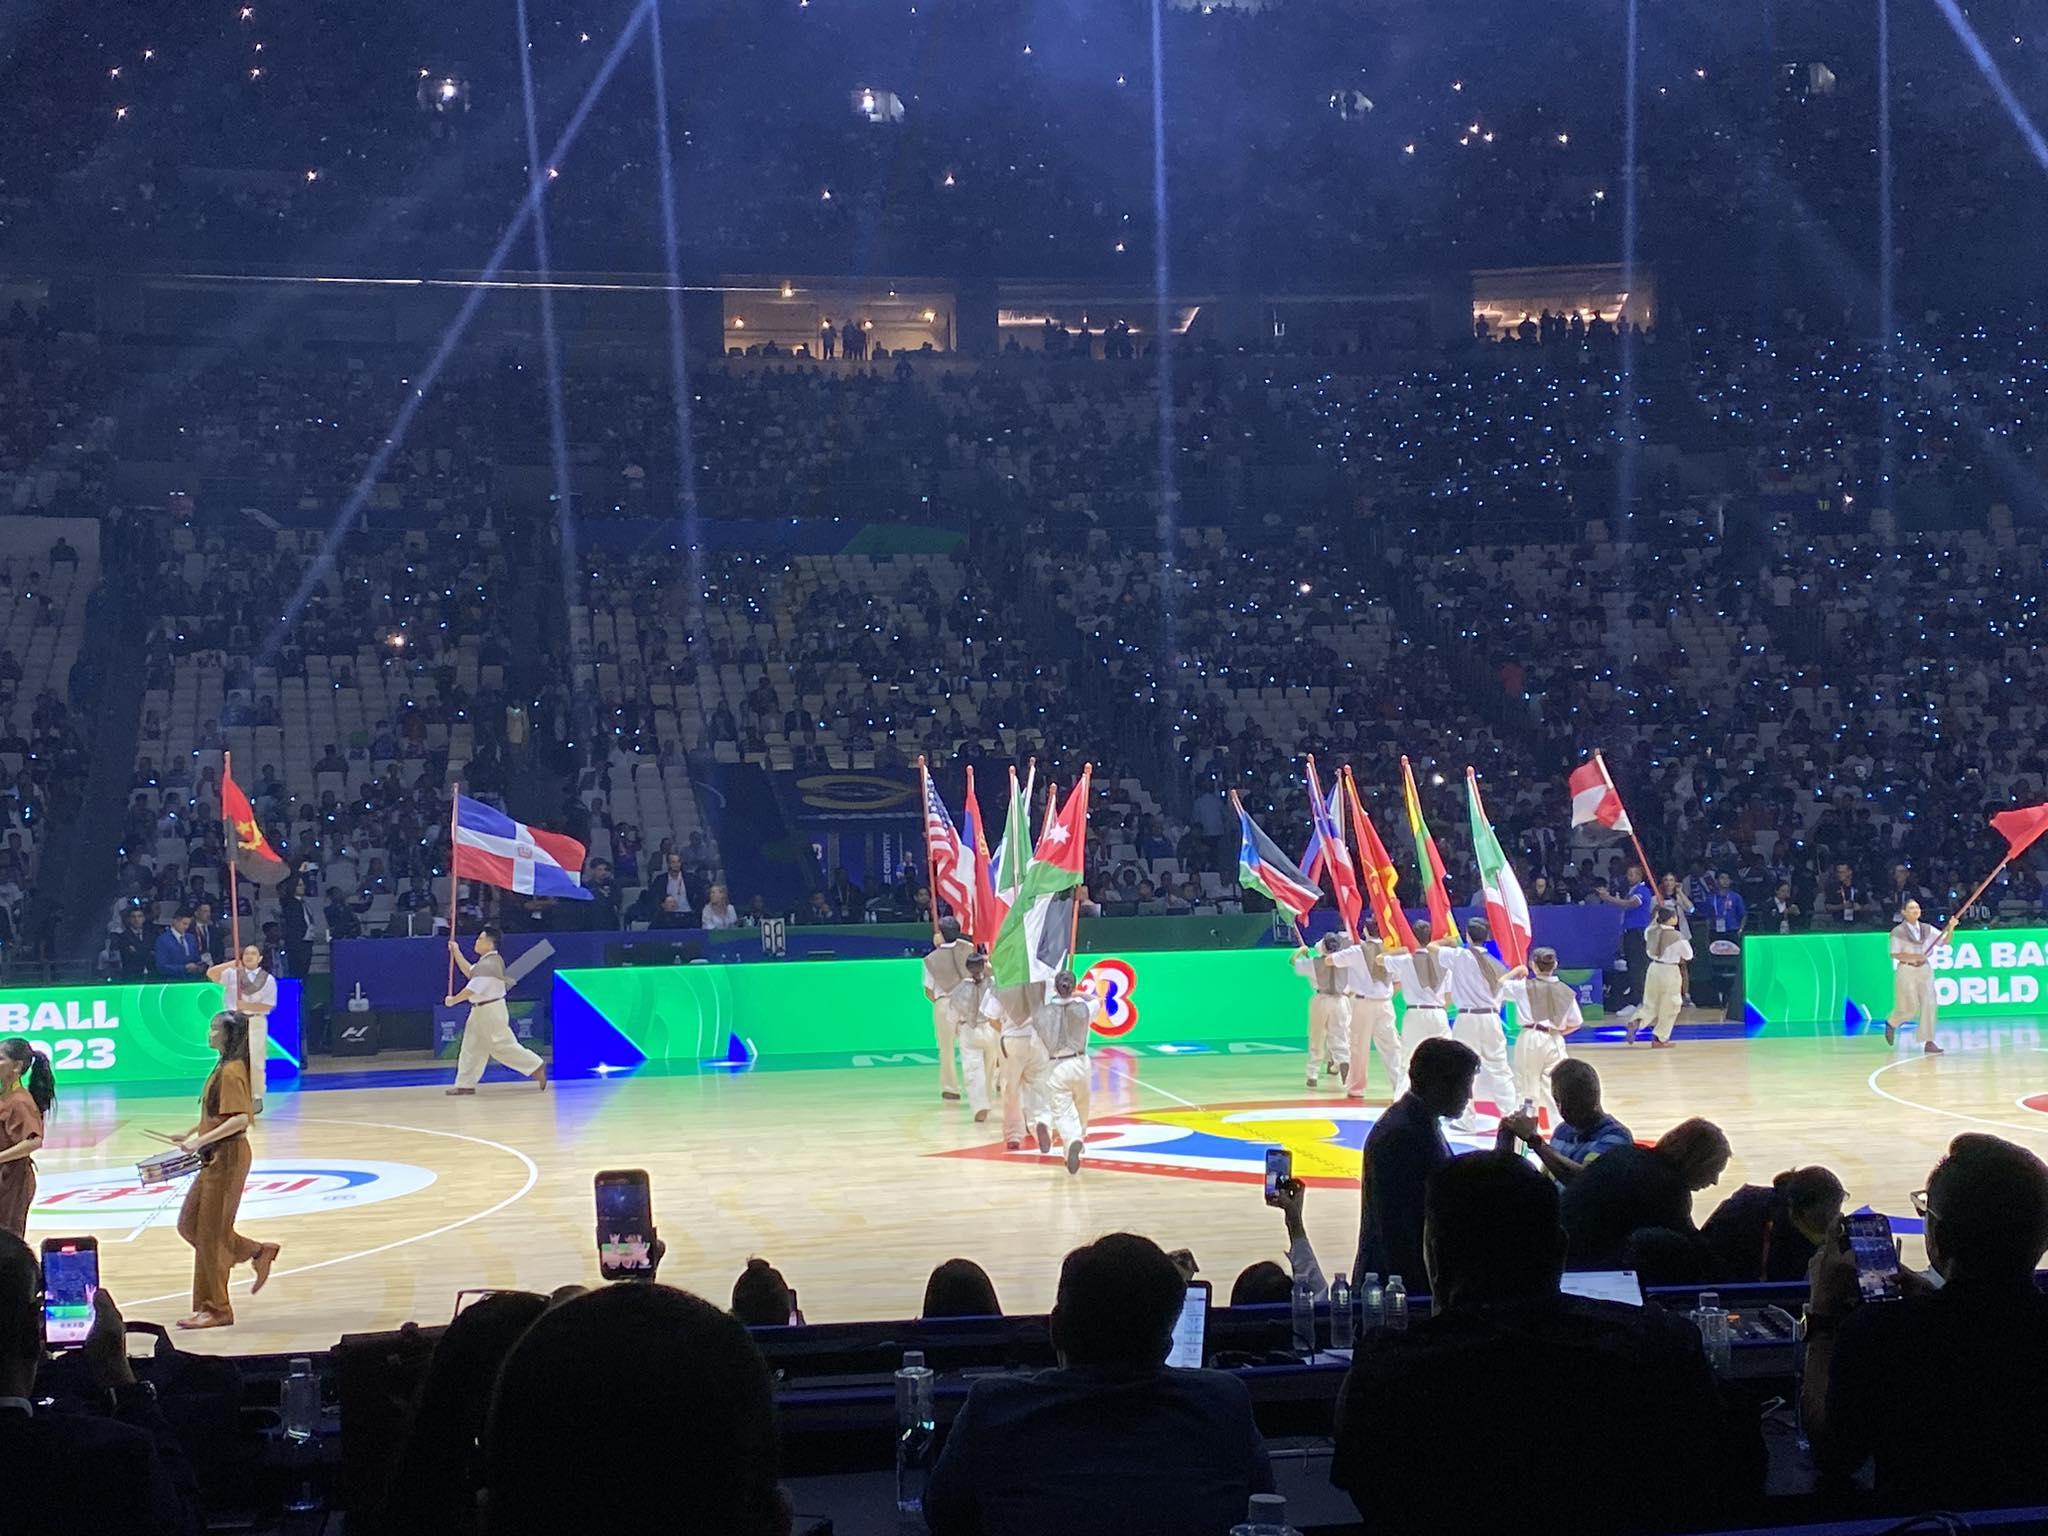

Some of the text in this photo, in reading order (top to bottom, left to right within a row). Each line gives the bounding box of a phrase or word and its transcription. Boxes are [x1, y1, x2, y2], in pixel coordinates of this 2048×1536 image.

[1990, 940, 2048, 968] BA
[1934, 975, 2039, 1006] ORLD
[0, 1000, 120, 1032] BALL
